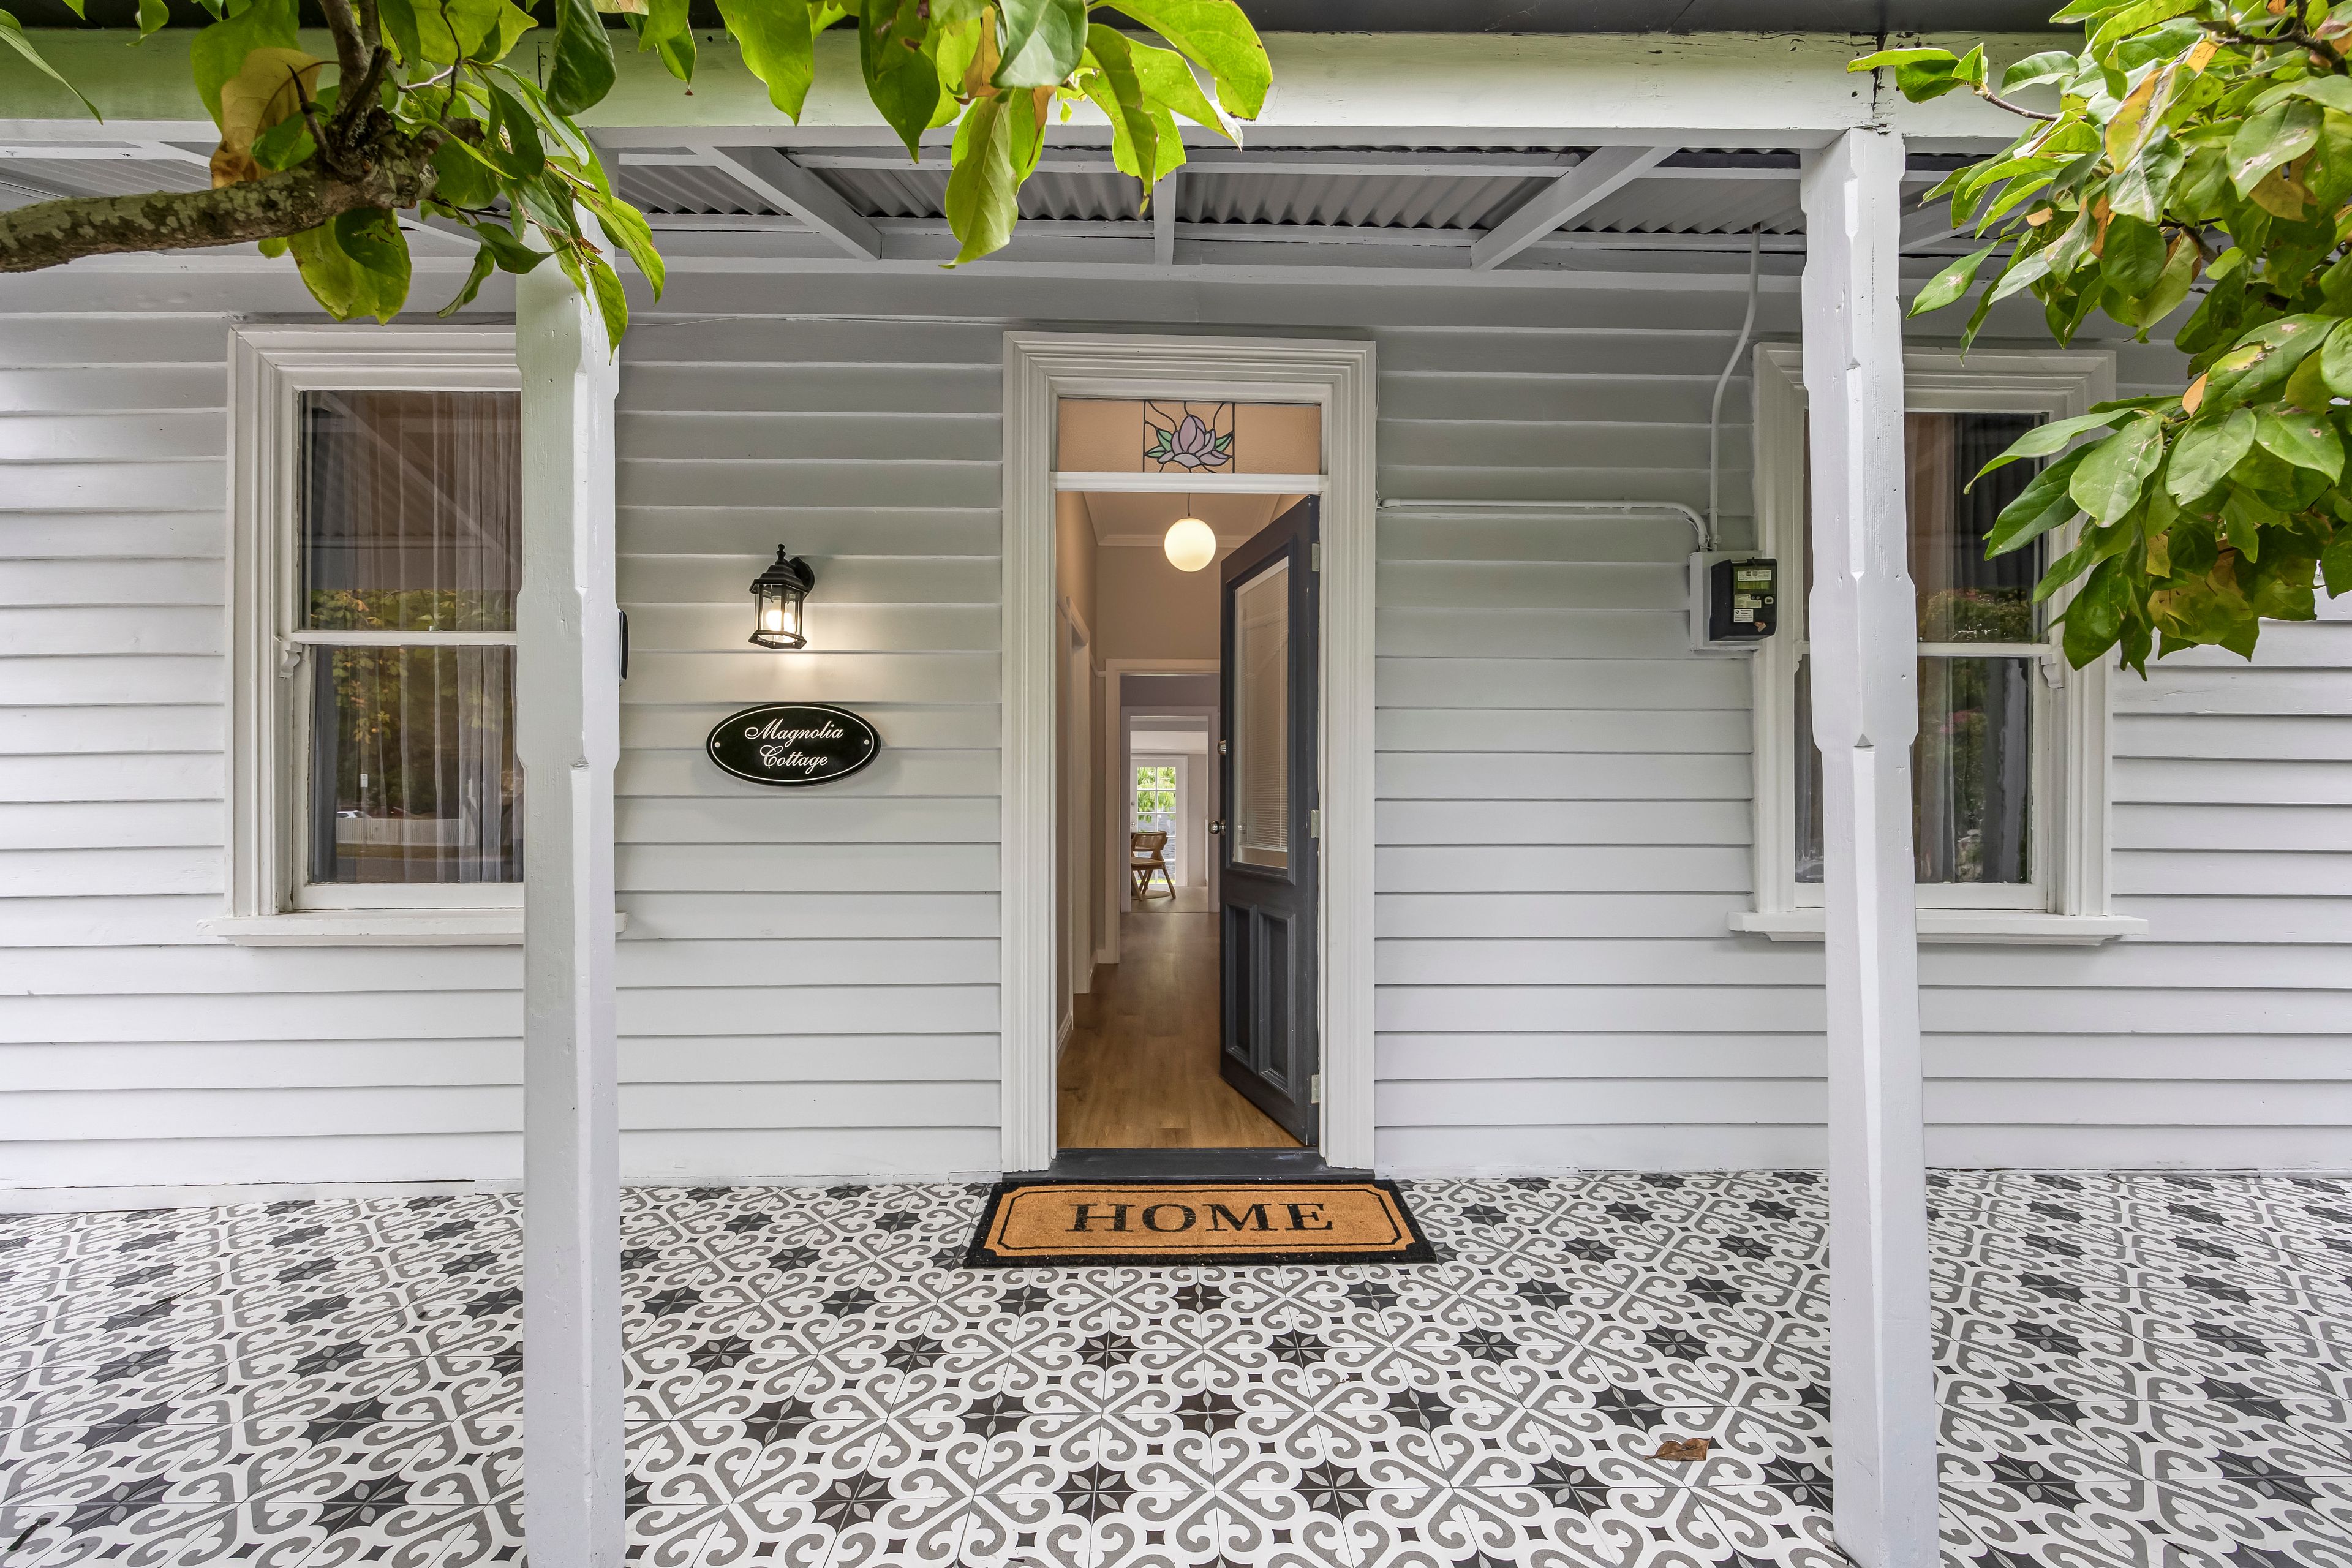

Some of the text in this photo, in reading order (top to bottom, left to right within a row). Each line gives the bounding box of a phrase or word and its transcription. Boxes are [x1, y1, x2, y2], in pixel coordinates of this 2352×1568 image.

[744, 718, 844, 747] Magnolia
[760, 745, 828, 774] Cottage
[1064, 1203, 1334, 1233] HOME
